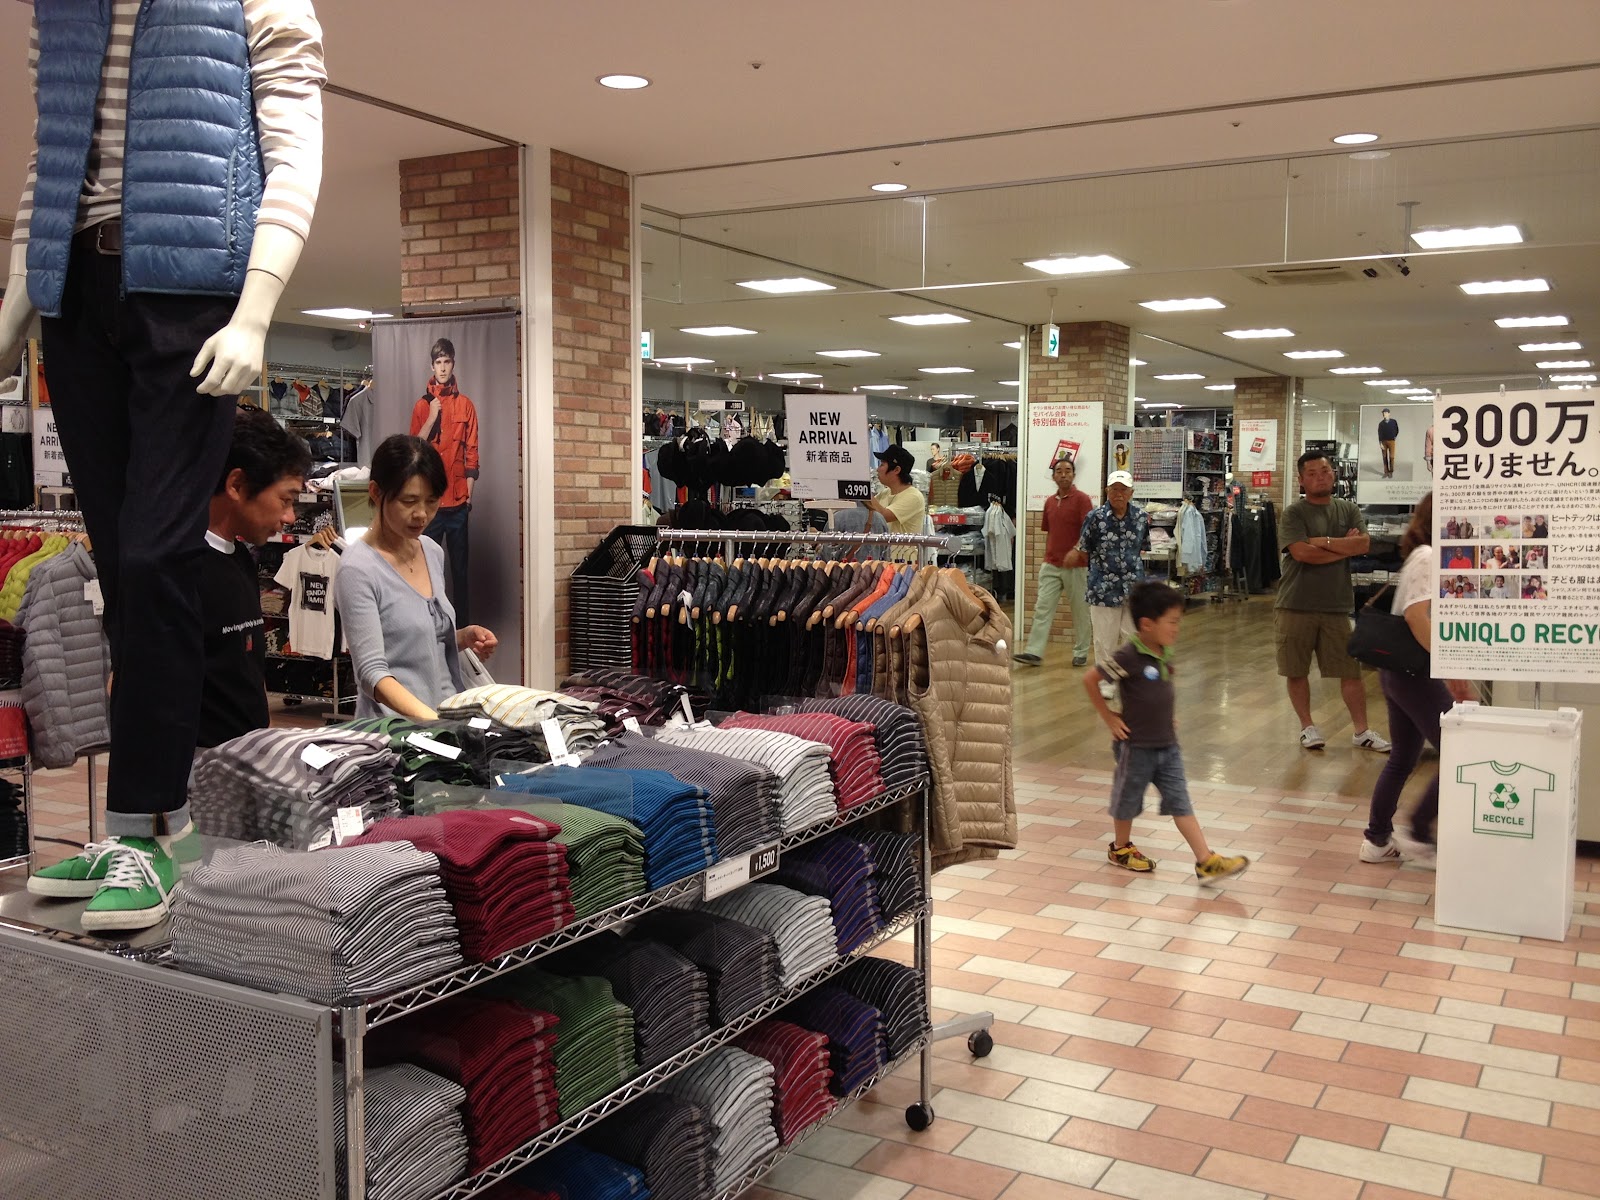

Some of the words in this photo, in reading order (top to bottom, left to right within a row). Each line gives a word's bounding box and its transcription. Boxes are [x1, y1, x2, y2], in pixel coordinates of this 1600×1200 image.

[809, 411, 841, 426] NEW
[1441, 400, 1595, 449] 300万
[46, 422, 58, 433] NE
[40, 435, 59, 447] ARRI
[798, 430, 857, 445] ARRIVAL
[44, 450, 64, 461] 新着商
[805, 450, 852, 464] 新着商品
[1440, 450, 1599, 481] 足りません。
[845, 484, 869, 497] ¥3,990
[1439, 621, 1526, 646] UNIQLO
[1534, 623, 1600, 645] RECY
[1482, 813, 1525, 826] RECYCLE
[755, 849, 776, 872] ¥1,500
